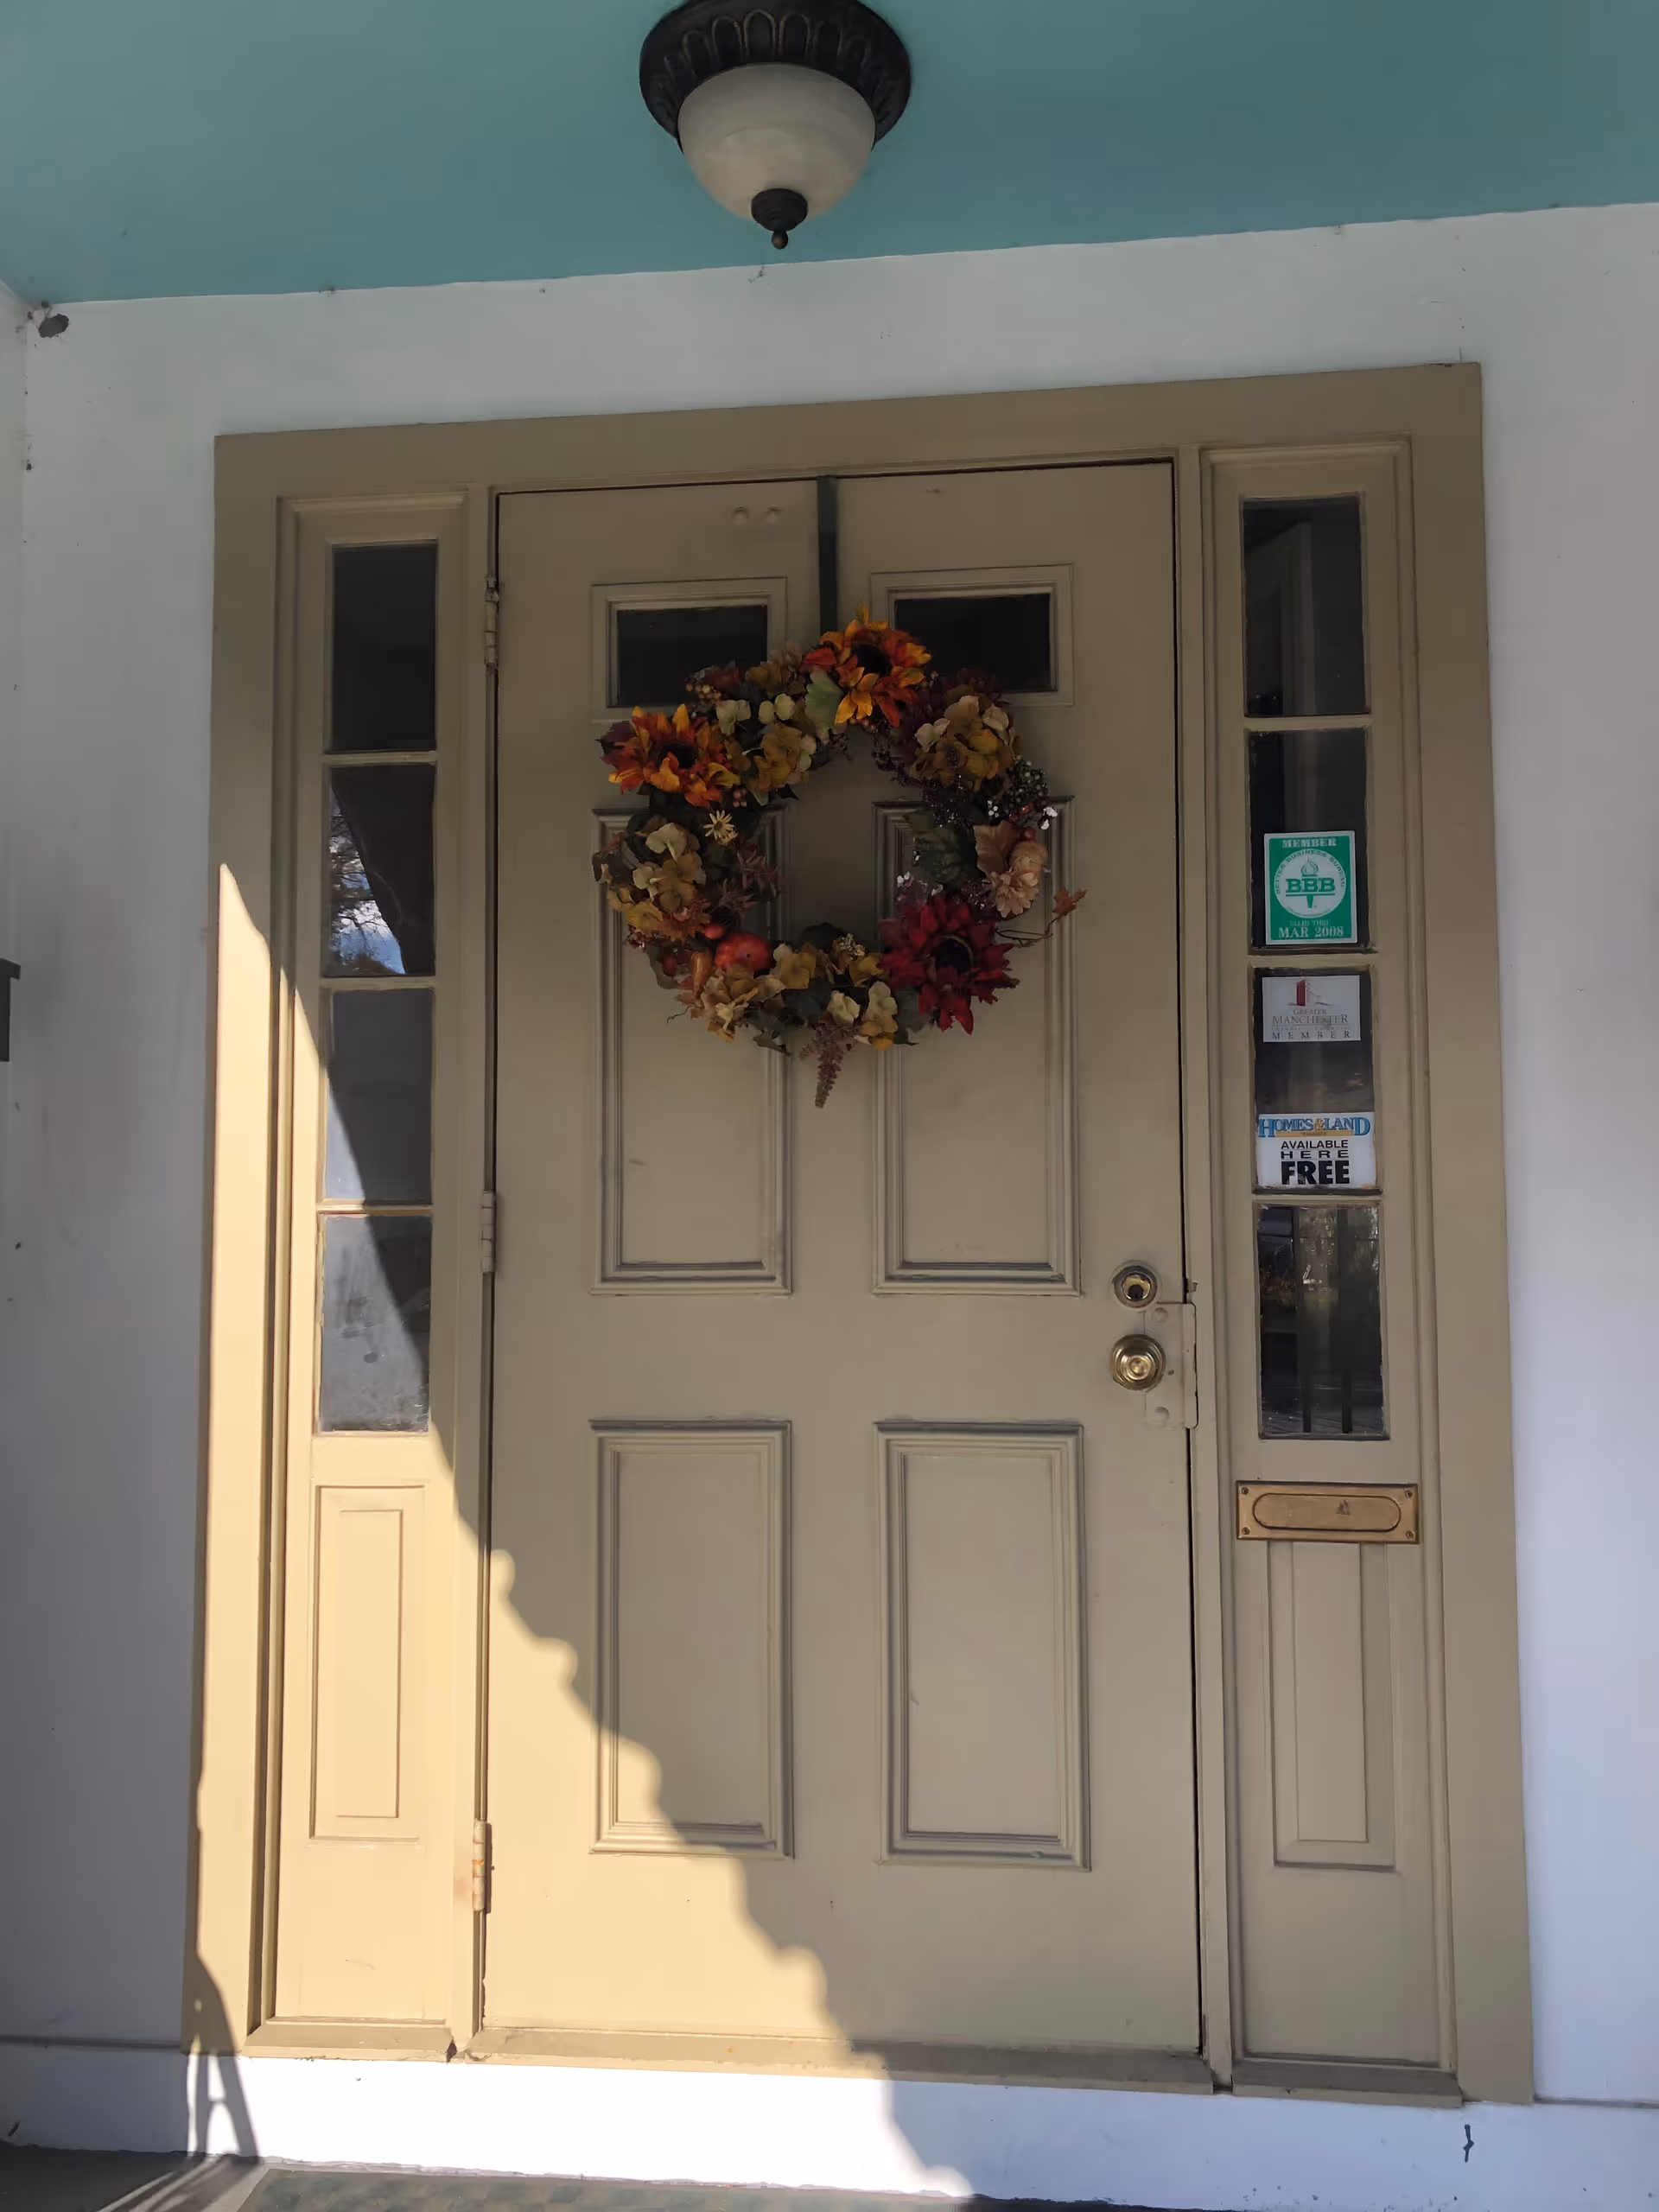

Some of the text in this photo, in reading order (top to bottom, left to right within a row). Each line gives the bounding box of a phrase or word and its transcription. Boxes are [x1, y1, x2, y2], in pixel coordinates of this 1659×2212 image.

[1282, 838, 1337, 849] MEMBER
[1286, 877, 1336, 893] BBB
[1279, 925, 1344, 938] MAR 2008
[1272, 1014, 1349, 1025] MANCHESTER
[1272, 1031, 1351, 1039] MEMBER
[1281, 1140, 1349, 1149] AVAILABLE
[1281, 1150, 1349, 1160] HERE
[1281, 1160, 1350, 1185] FREE
